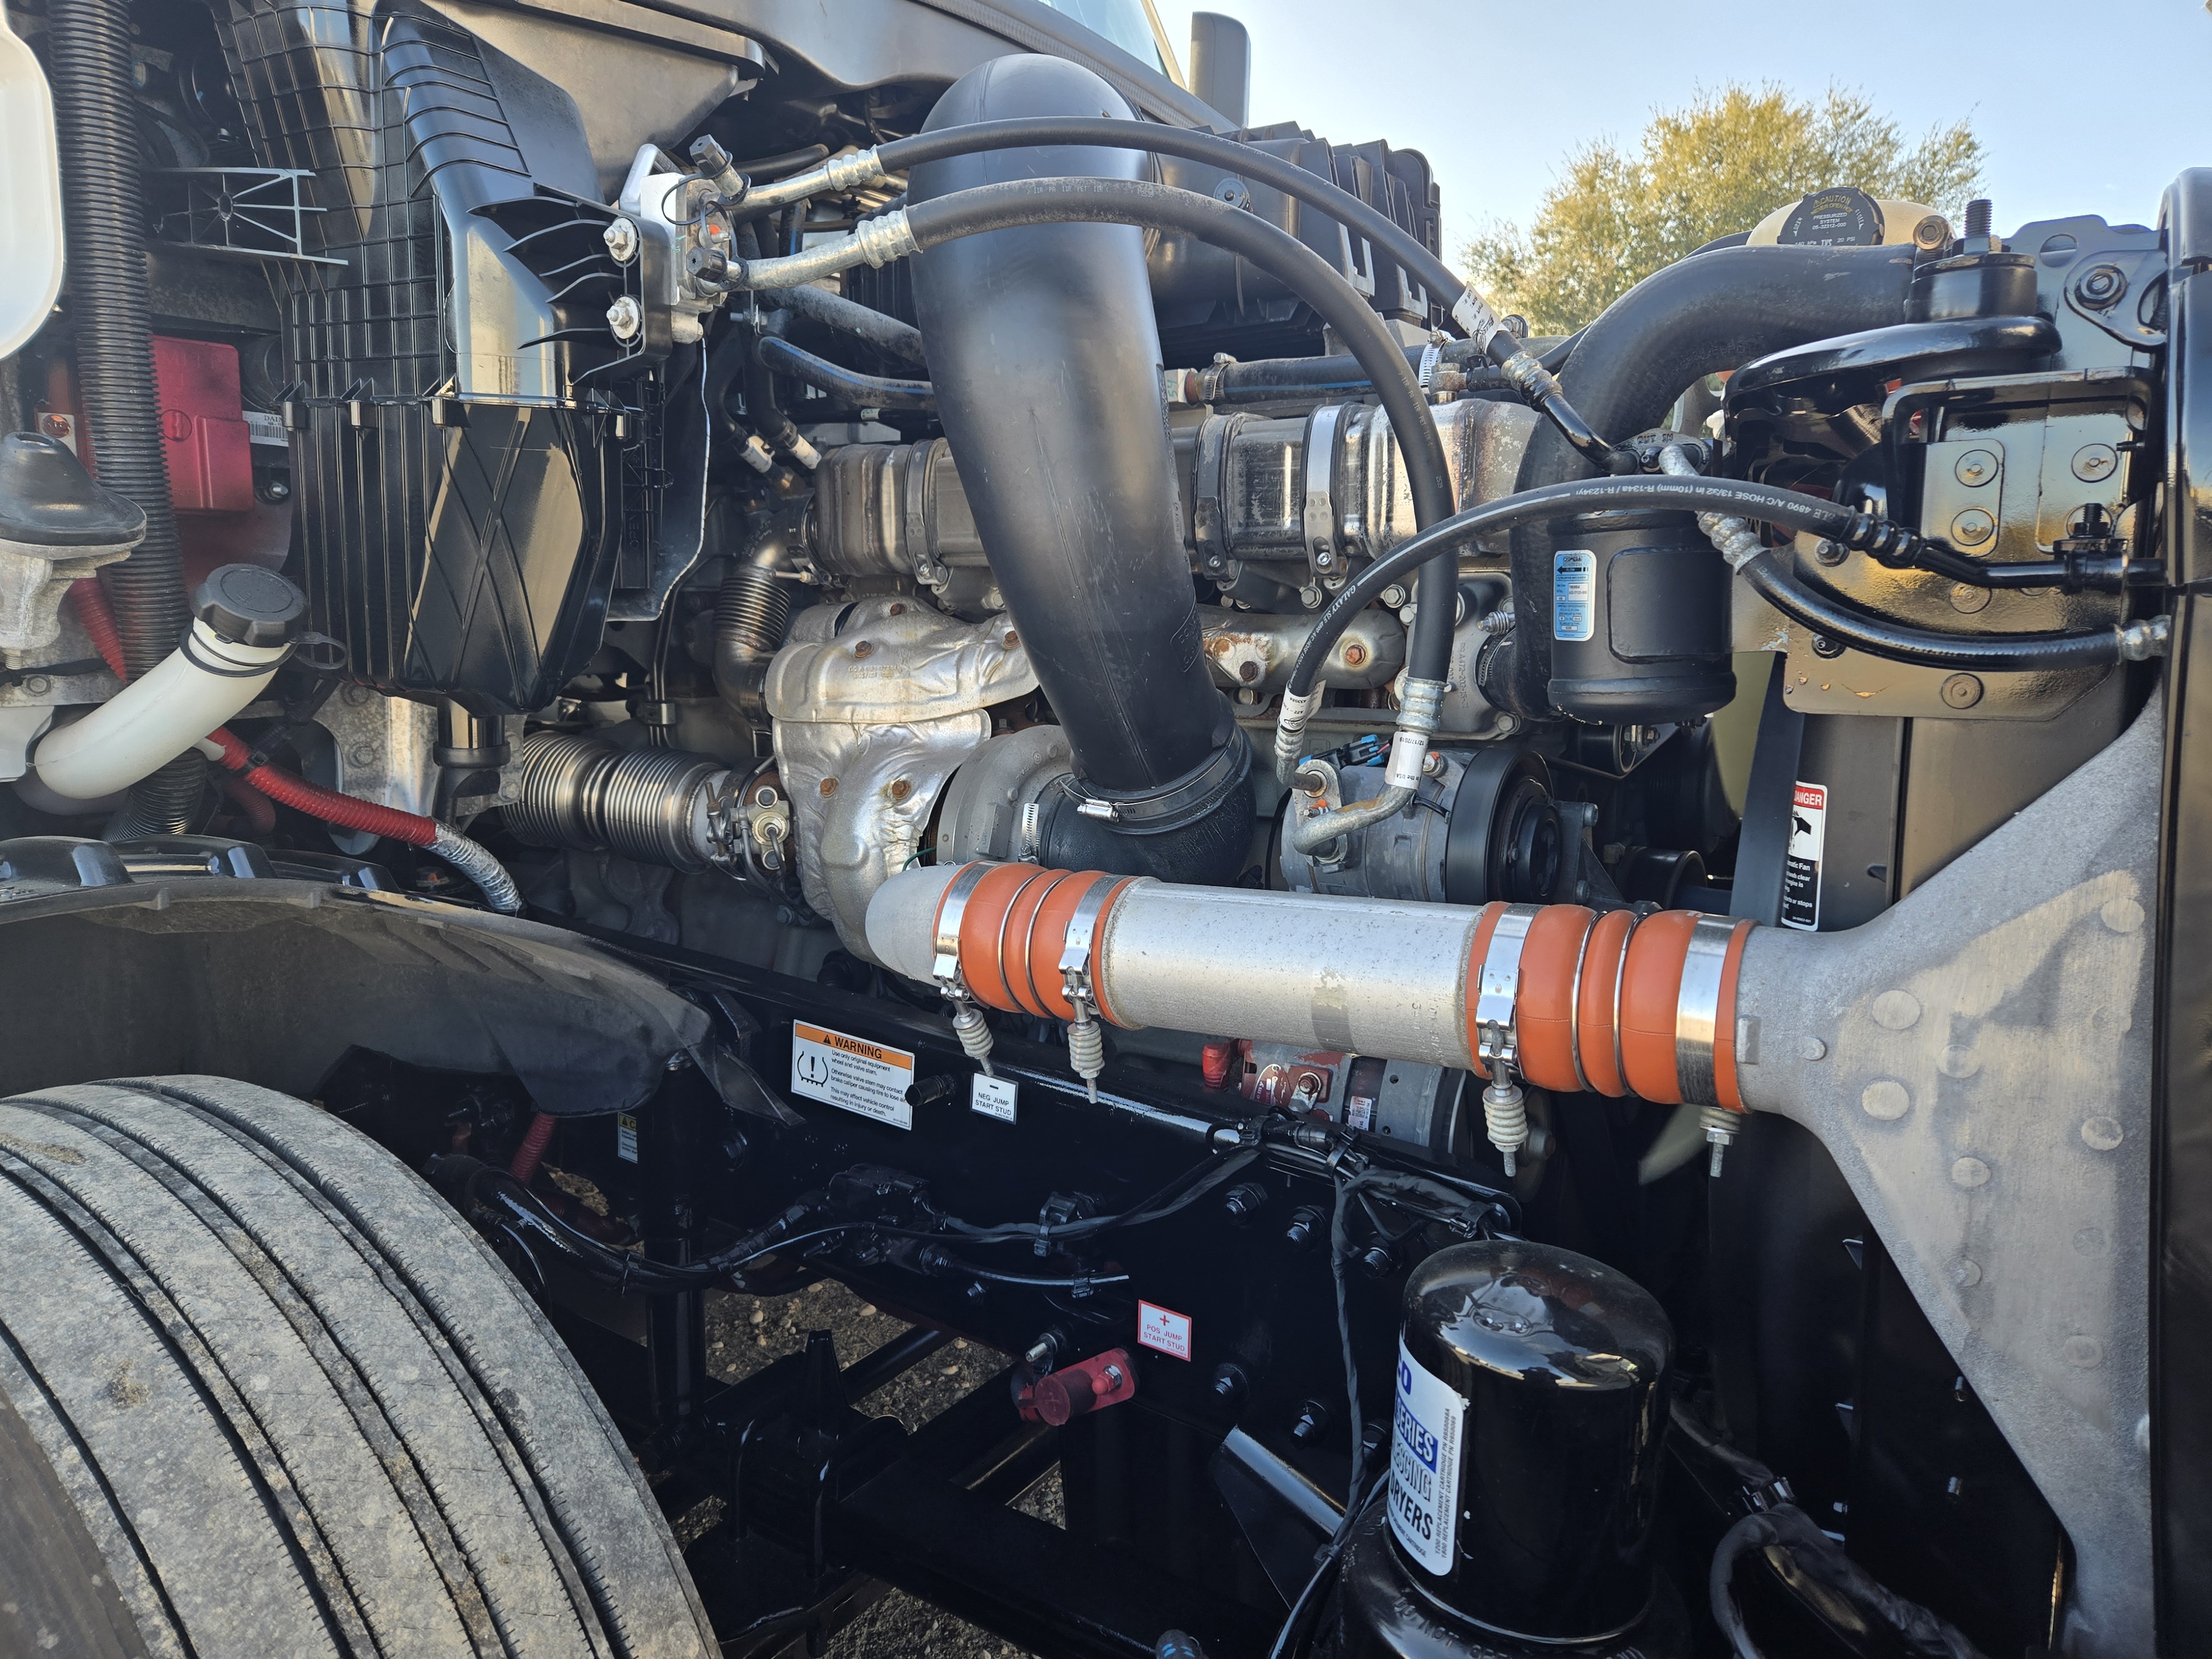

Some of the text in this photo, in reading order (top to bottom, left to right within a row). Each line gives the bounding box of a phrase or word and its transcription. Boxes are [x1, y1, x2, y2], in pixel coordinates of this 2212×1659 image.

[1820, 195, 1851, 205] CAUTION
[1811, 204, 1828, 215] NEVER
[1657, 484, 1693, 493] (10mm)
[1707, 487, 1733, 497] 13/32
[1734, 491, 1765, 503] HOSE
[1766, 497, 1785, 507] A/C
[1787, 502, 1812, 514] 4890
[1332, 585, 1356, 614] GALAXY
[1400, 737, 1424, 745] 12/17/2019
[834, 1036, 882, 1059] WARNING
[851, 1055, 867, 1064] original
[868, 1061, 891, 1072] equipment
[831, 1068, 852, 1079] Otherwise
[886, 1086, 903, 1095] contact
[831, 1075, 843, 1083] brake
[843, 1079, 858, 1088] caliper
[858, 1083, 875, 1094] causing
[889, 1093, 899, 1101] lose
[831, 1094, 848, 1105] resulting
[854, 1101, 867, 1111] injury
[873, 1108, 886, 1117] death.
[863, 1097, 878, 1106] vehicle
[879, 1103, 894, 1112] control
[975, 1099, 1011, 1115] START STUD
[978, 1092, 1009, 1106] NEG JUMP
[1147, 1324, 1182, 1341] POS JUMP
[1144, 1332, 1165, 1344] START
[1167, 1340, 1185, 1352] STUD
[1395, 1396, 1435, 1464] SERIES
[1436, 1492, 1444, 1539] REPLACEMENT
[1443, 1441, 1448, 1452] PN
[1442, 1495, 1451, 1542] REPLACEMENT
[1449, 1444, 1454, 1455] PN
[1389, 1469, 1434, 1541] DRYERS
